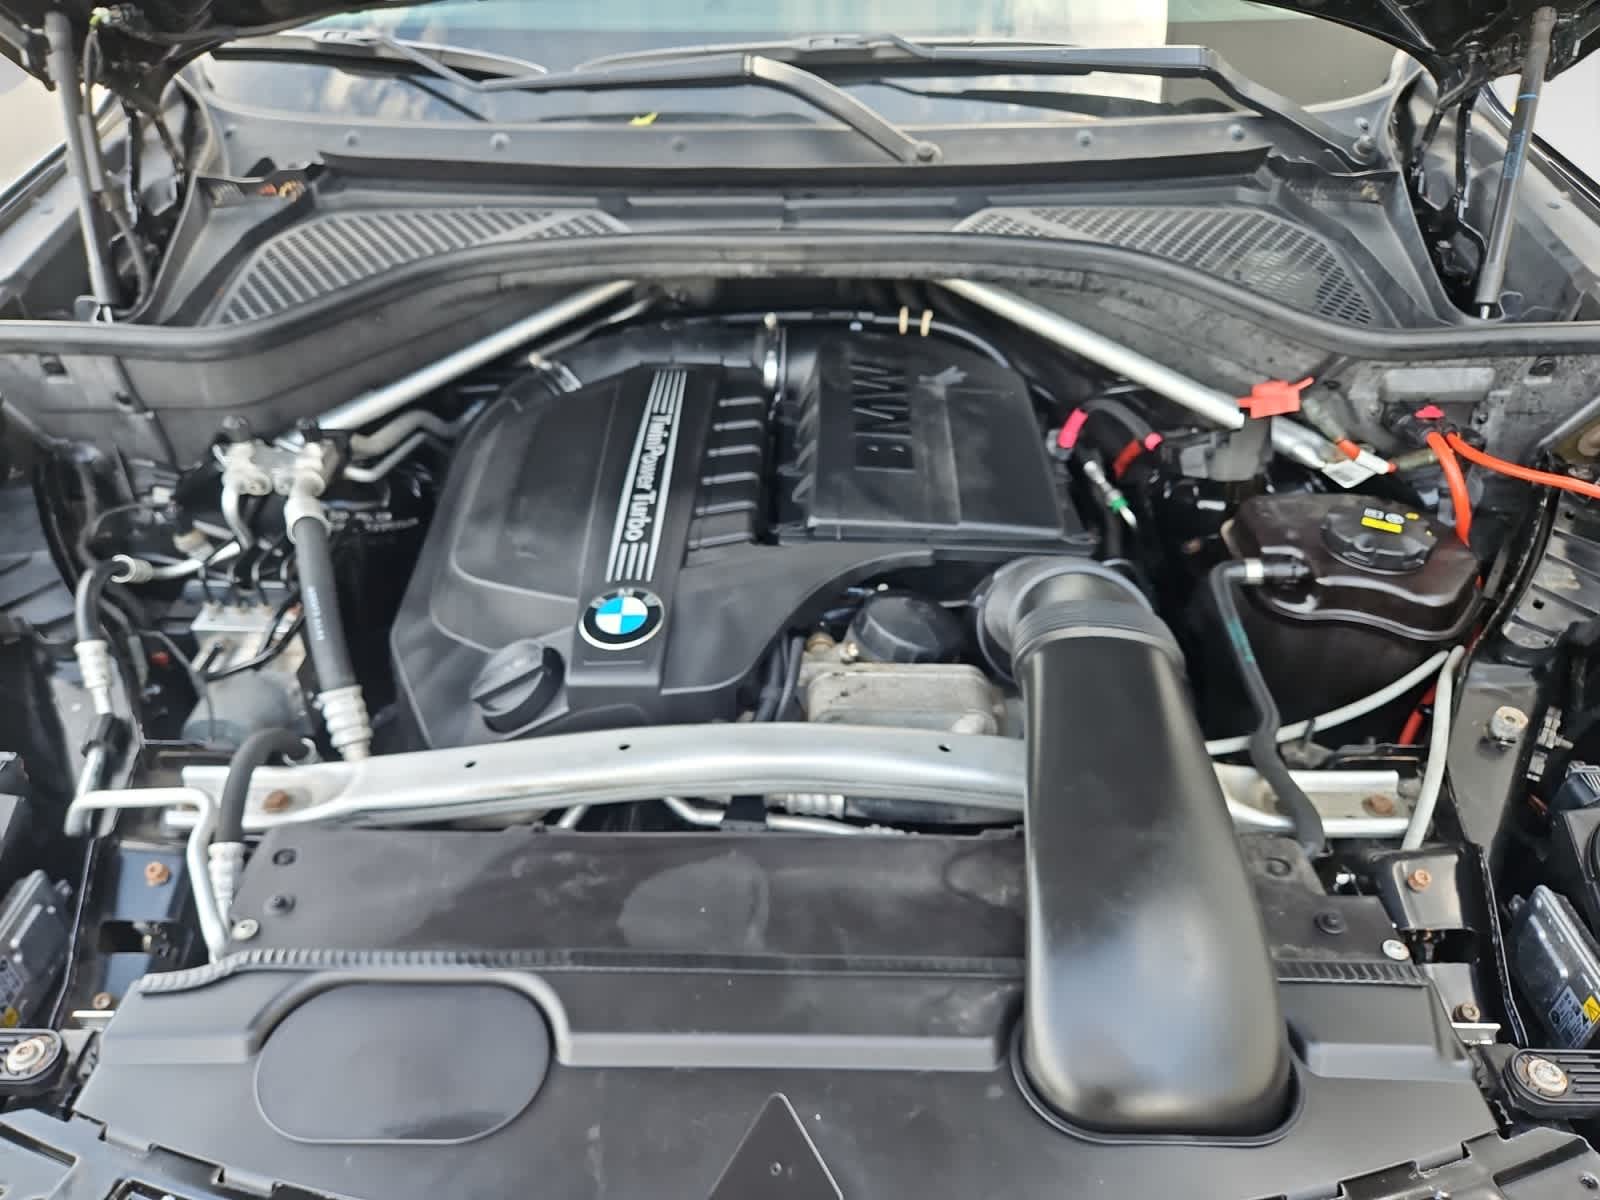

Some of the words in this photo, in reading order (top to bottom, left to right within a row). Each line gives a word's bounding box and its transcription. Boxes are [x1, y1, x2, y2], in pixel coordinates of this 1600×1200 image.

[635, 414, 672, 490] TwinPower
[849, 361, 914, 473] BMW
[624, 490, 657, 542] Turbo
